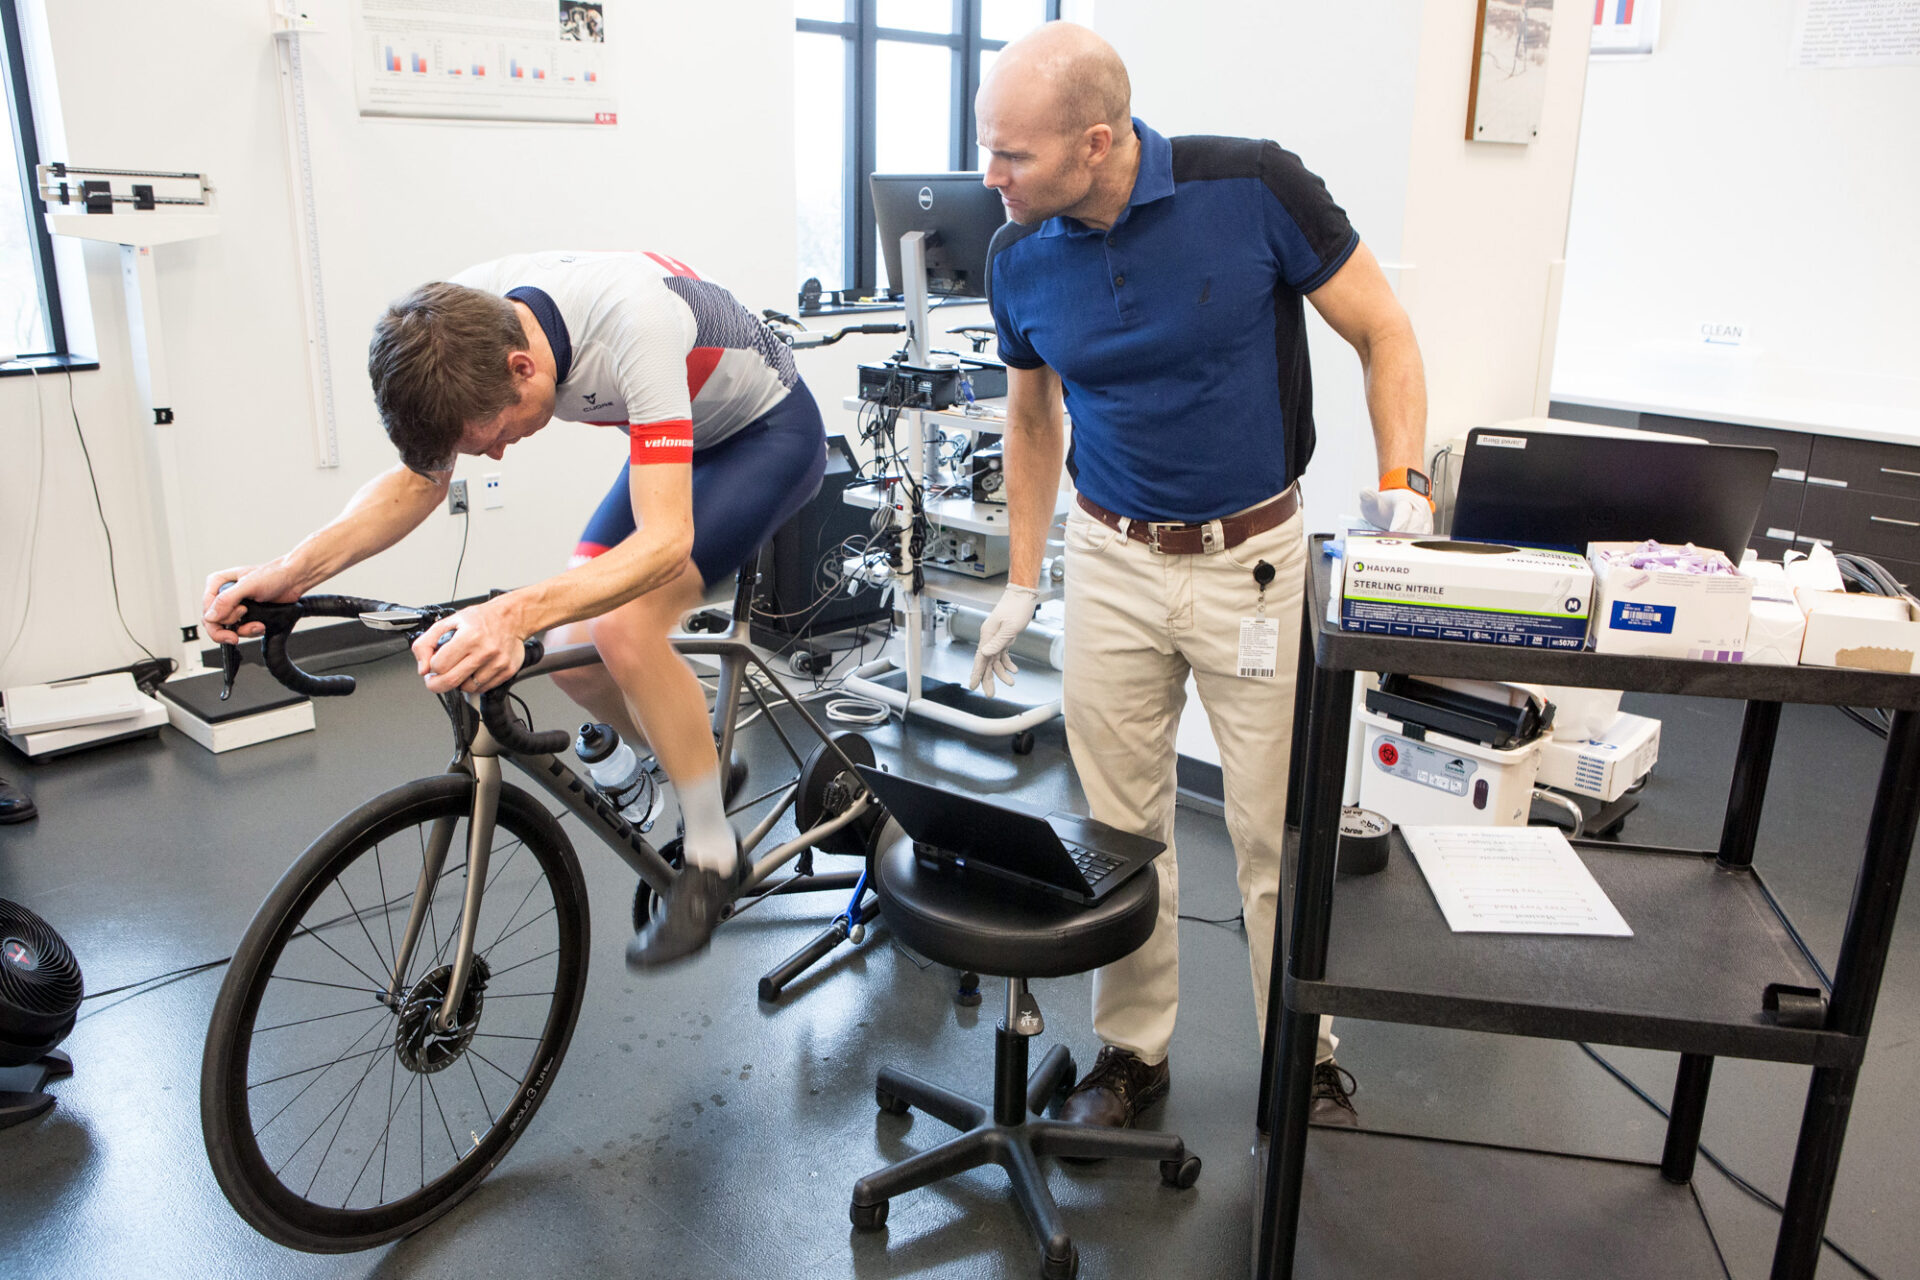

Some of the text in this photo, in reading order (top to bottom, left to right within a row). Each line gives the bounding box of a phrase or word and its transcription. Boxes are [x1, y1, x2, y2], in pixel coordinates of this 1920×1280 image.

[1701, 323, 1743, 337] CLEAN
[1366, 565, 1410, 575] HALYARD
[1353, 580, 1445, 596] STERLING NITRILE
[1567, 601, 1579, 610] M
